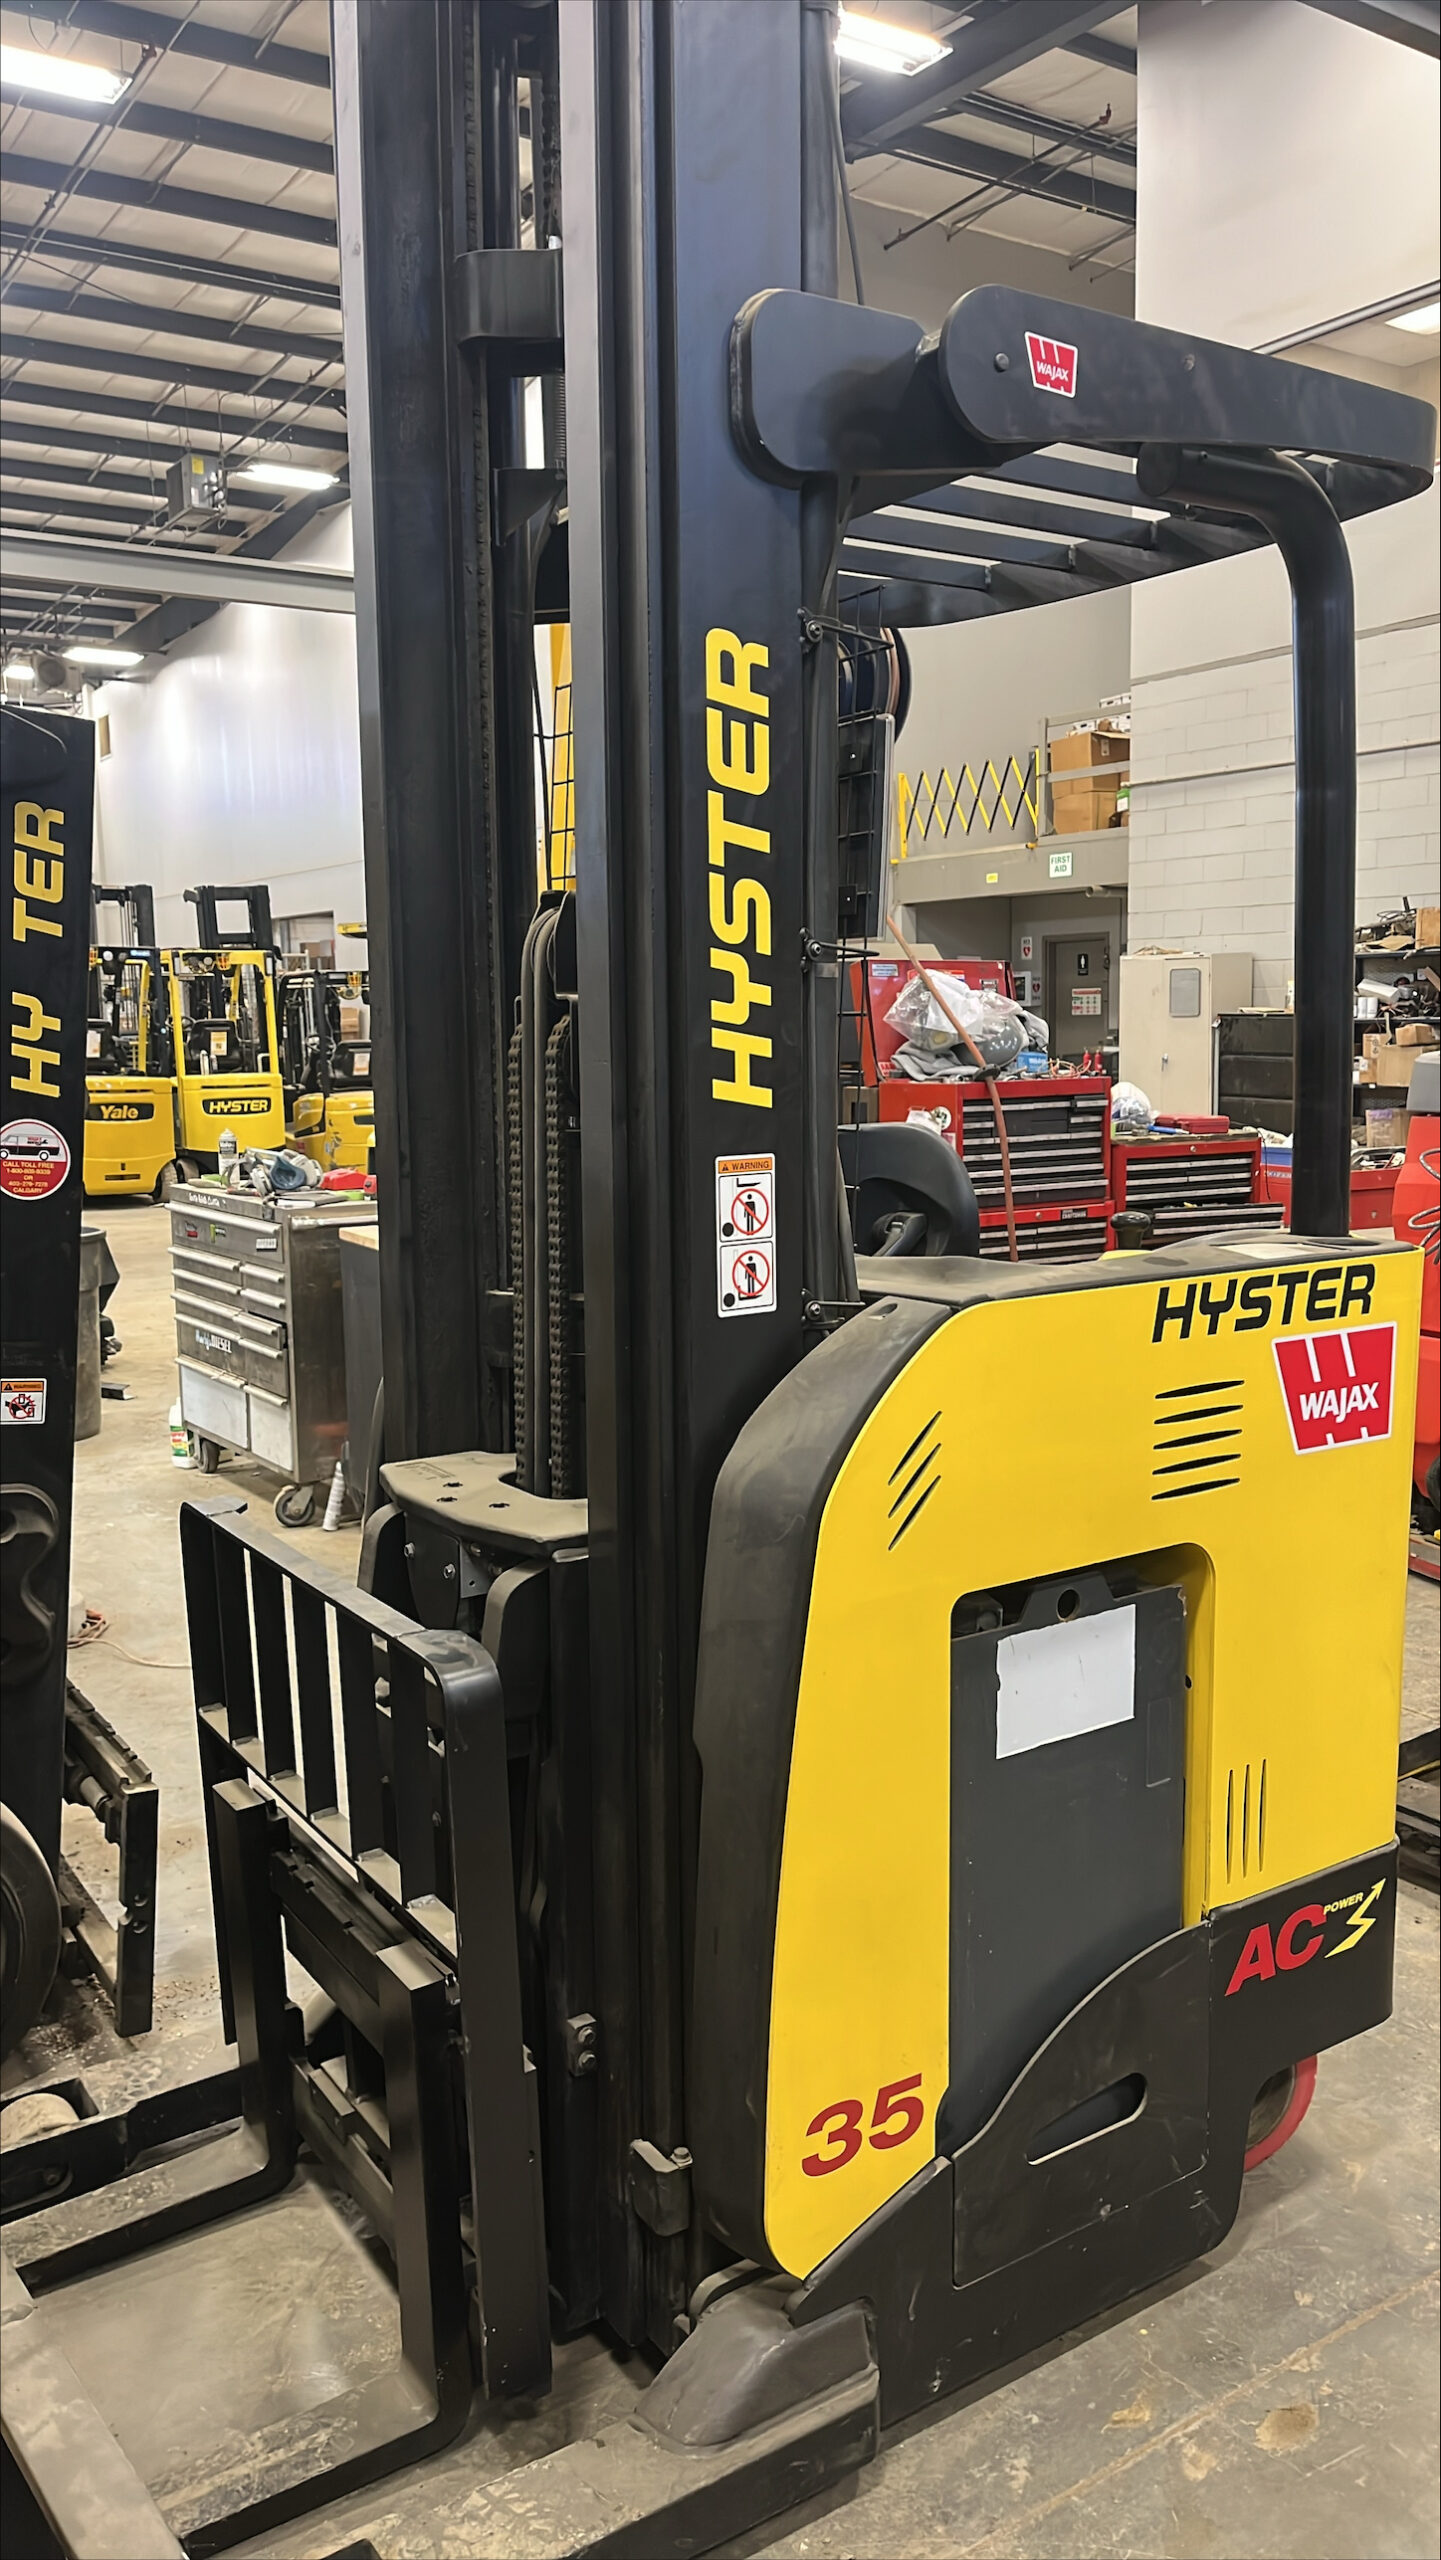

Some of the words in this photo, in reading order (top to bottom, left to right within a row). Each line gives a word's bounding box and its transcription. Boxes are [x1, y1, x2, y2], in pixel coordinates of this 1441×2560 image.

[1036, 360, 1069, 382] WAJAX
[1050, 855, 1071, 865] FIRST
[705, 627, 774, 1109] HYSTER
[1054, 865, 1067, 873] AID
[100, 1105, 139, 1119] Yale
[209, 1099, 268, 1113] HYSTER
[21, 1161, 37, 1169] TOLL
[731, 1160, 769, 1171] WARNING
[12, 1186, 44, 1194] CALGARY
[1152, 1263, 1376, 1343] HYSTER
[1299, 1382, 1380, 1424] WAJAX
[1224, 1904, 1328, 1997] AC
[1322, 1892, 1365, 1916] POWER
[801, 2072, 925, 2177] 35
